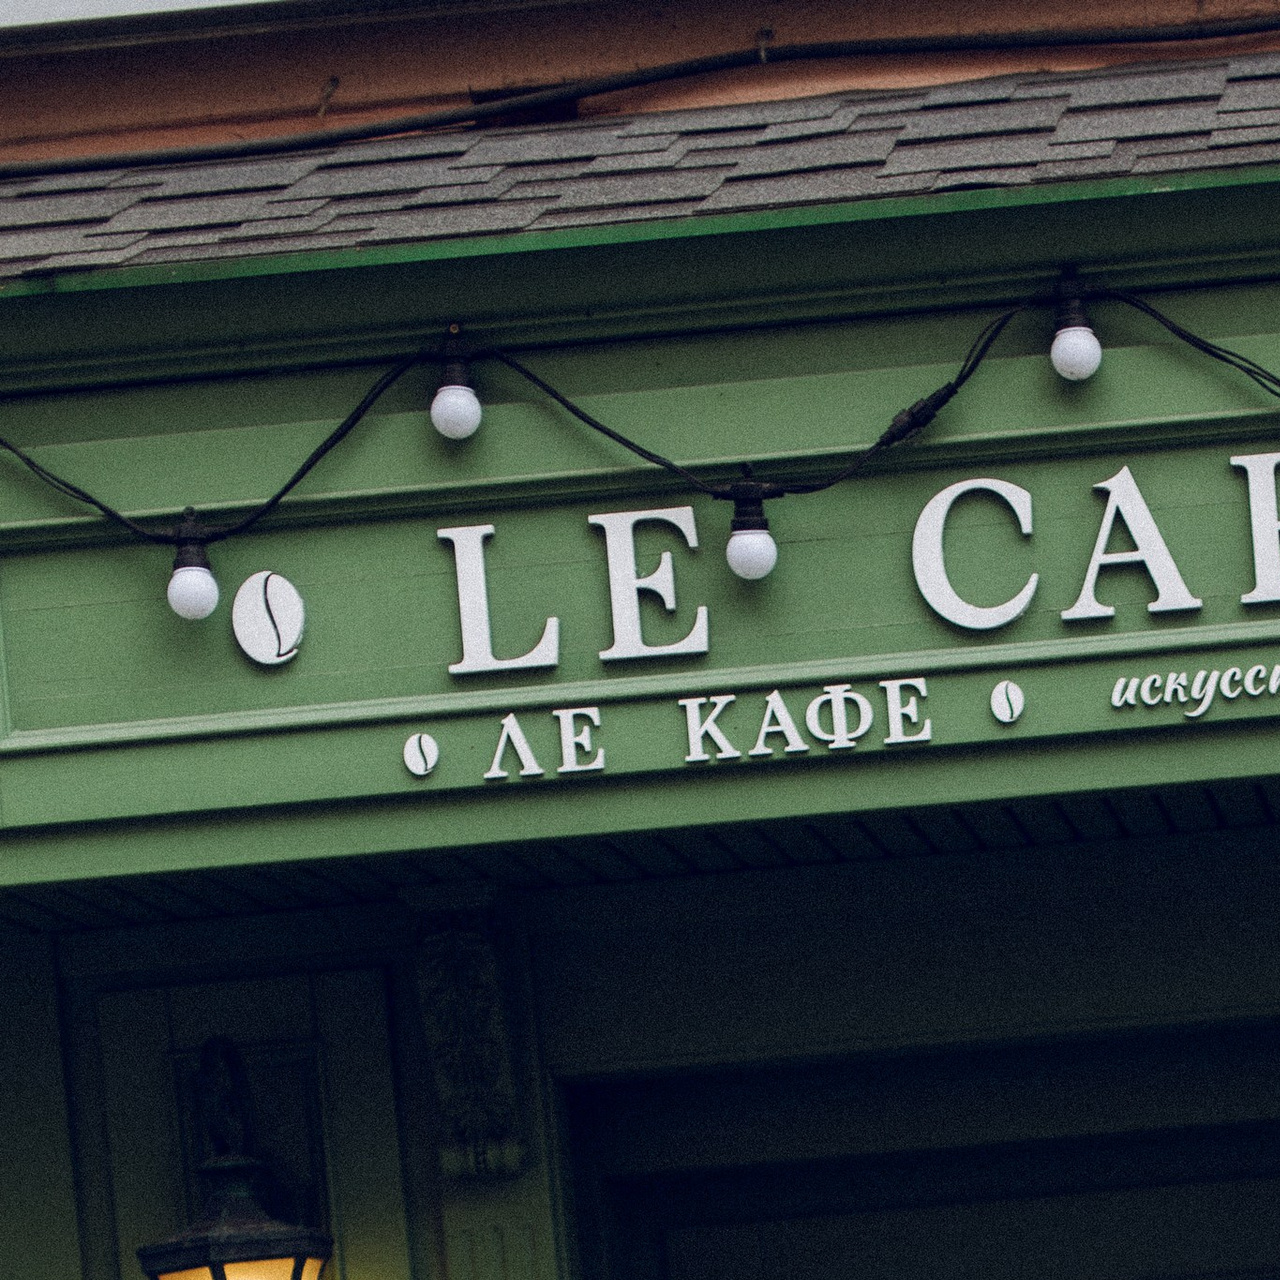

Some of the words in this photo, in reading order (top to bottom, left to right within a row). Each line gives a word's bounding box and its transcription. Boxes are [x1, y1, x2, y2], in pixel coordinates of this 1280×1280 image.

[437, 506, 709, 675] LE
[484, 707, 605, 780] ЛЕ
[678, 677, 933, 763] КАФЕ
